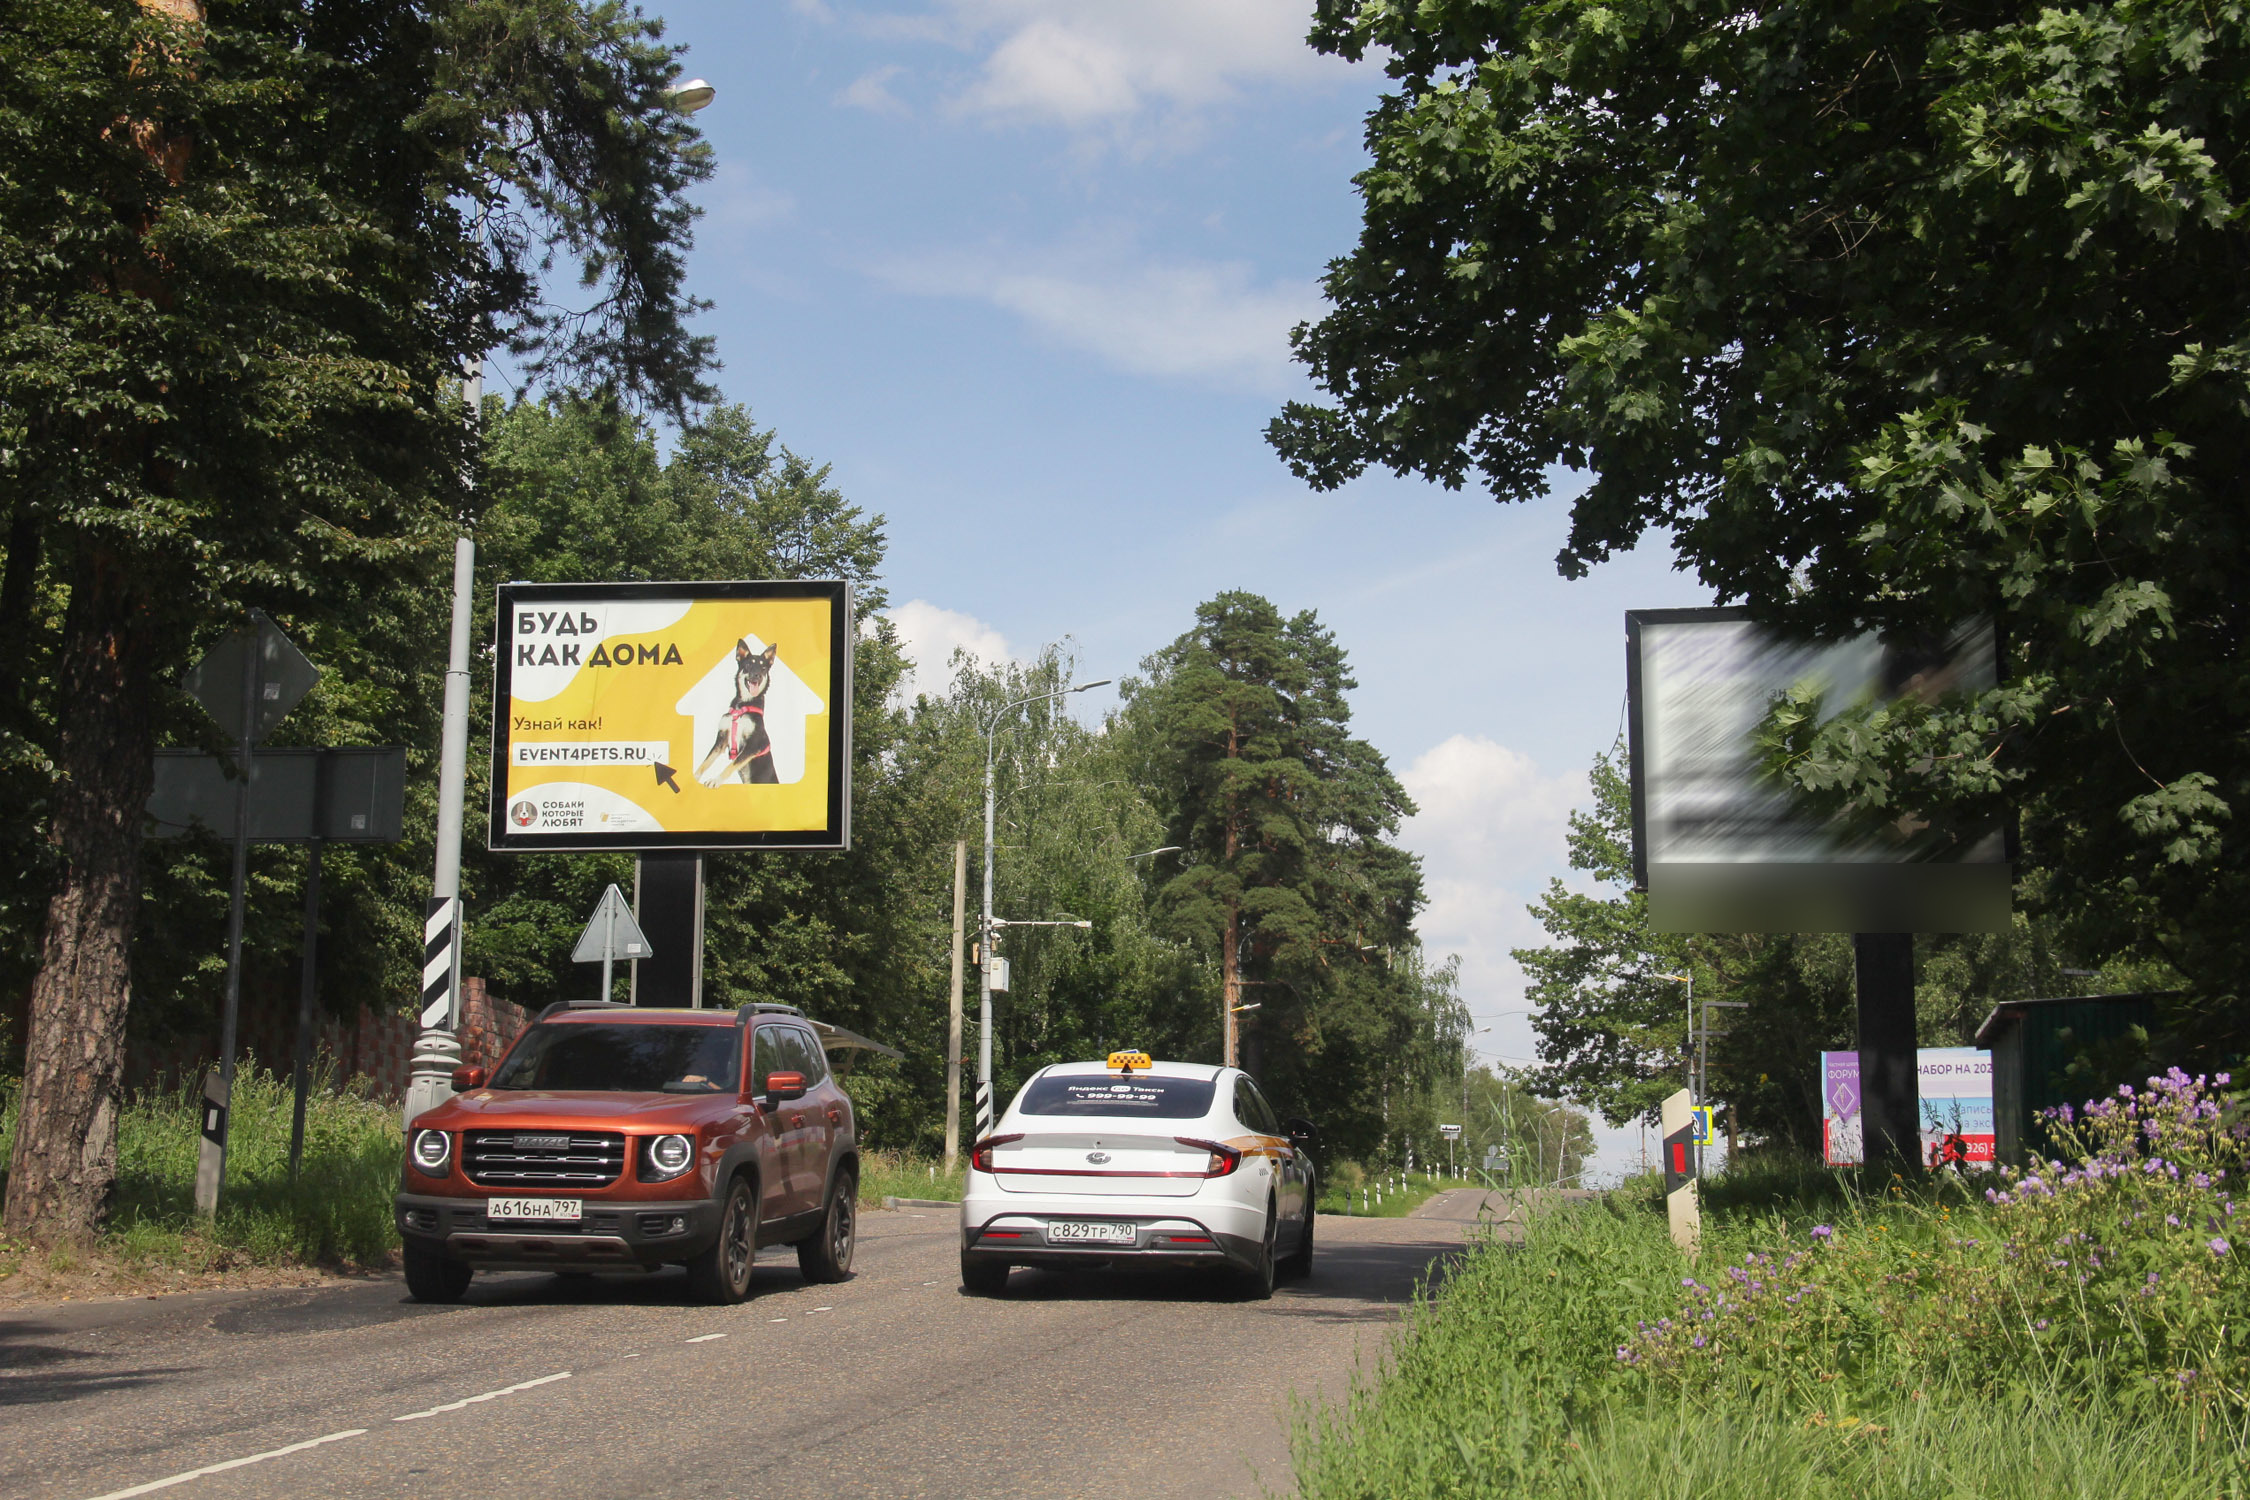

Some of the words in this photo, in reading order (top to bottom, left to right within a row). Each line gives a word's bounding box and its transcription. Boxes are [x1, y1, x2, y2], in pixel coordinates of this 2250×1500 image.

[518, 612, 598, 636] БУДЬ
[517, 644, 581, 667] КАК
[589, 643, 684, 668] ДОМА
[514, 716, 563, 731] Узнай
[568, 716, 603, 730] как!
[519, 747, 647, 761] EVENT4PETS.RU
[542, 801, 584, 809] СОБАКИ
[542, 818, 584, 827] ЛЮБЯТ
[1828, 1069, 1859, 1079] ФОРУМ
[1955, 1064, 1971, 1074] НА
[1960, 1105, 1992, 1114] апись
[516, 1138, 567, 1147] HAVAL
[1966, 1142, 1987, 1156] 926)
[493, 1200, 551, 1216] А616НА
[554, 1201, 577, 1213] 797
[1053, 1224, 1107, 1237] С829ТР
[1111, 1224, 1132, 1235] 790
